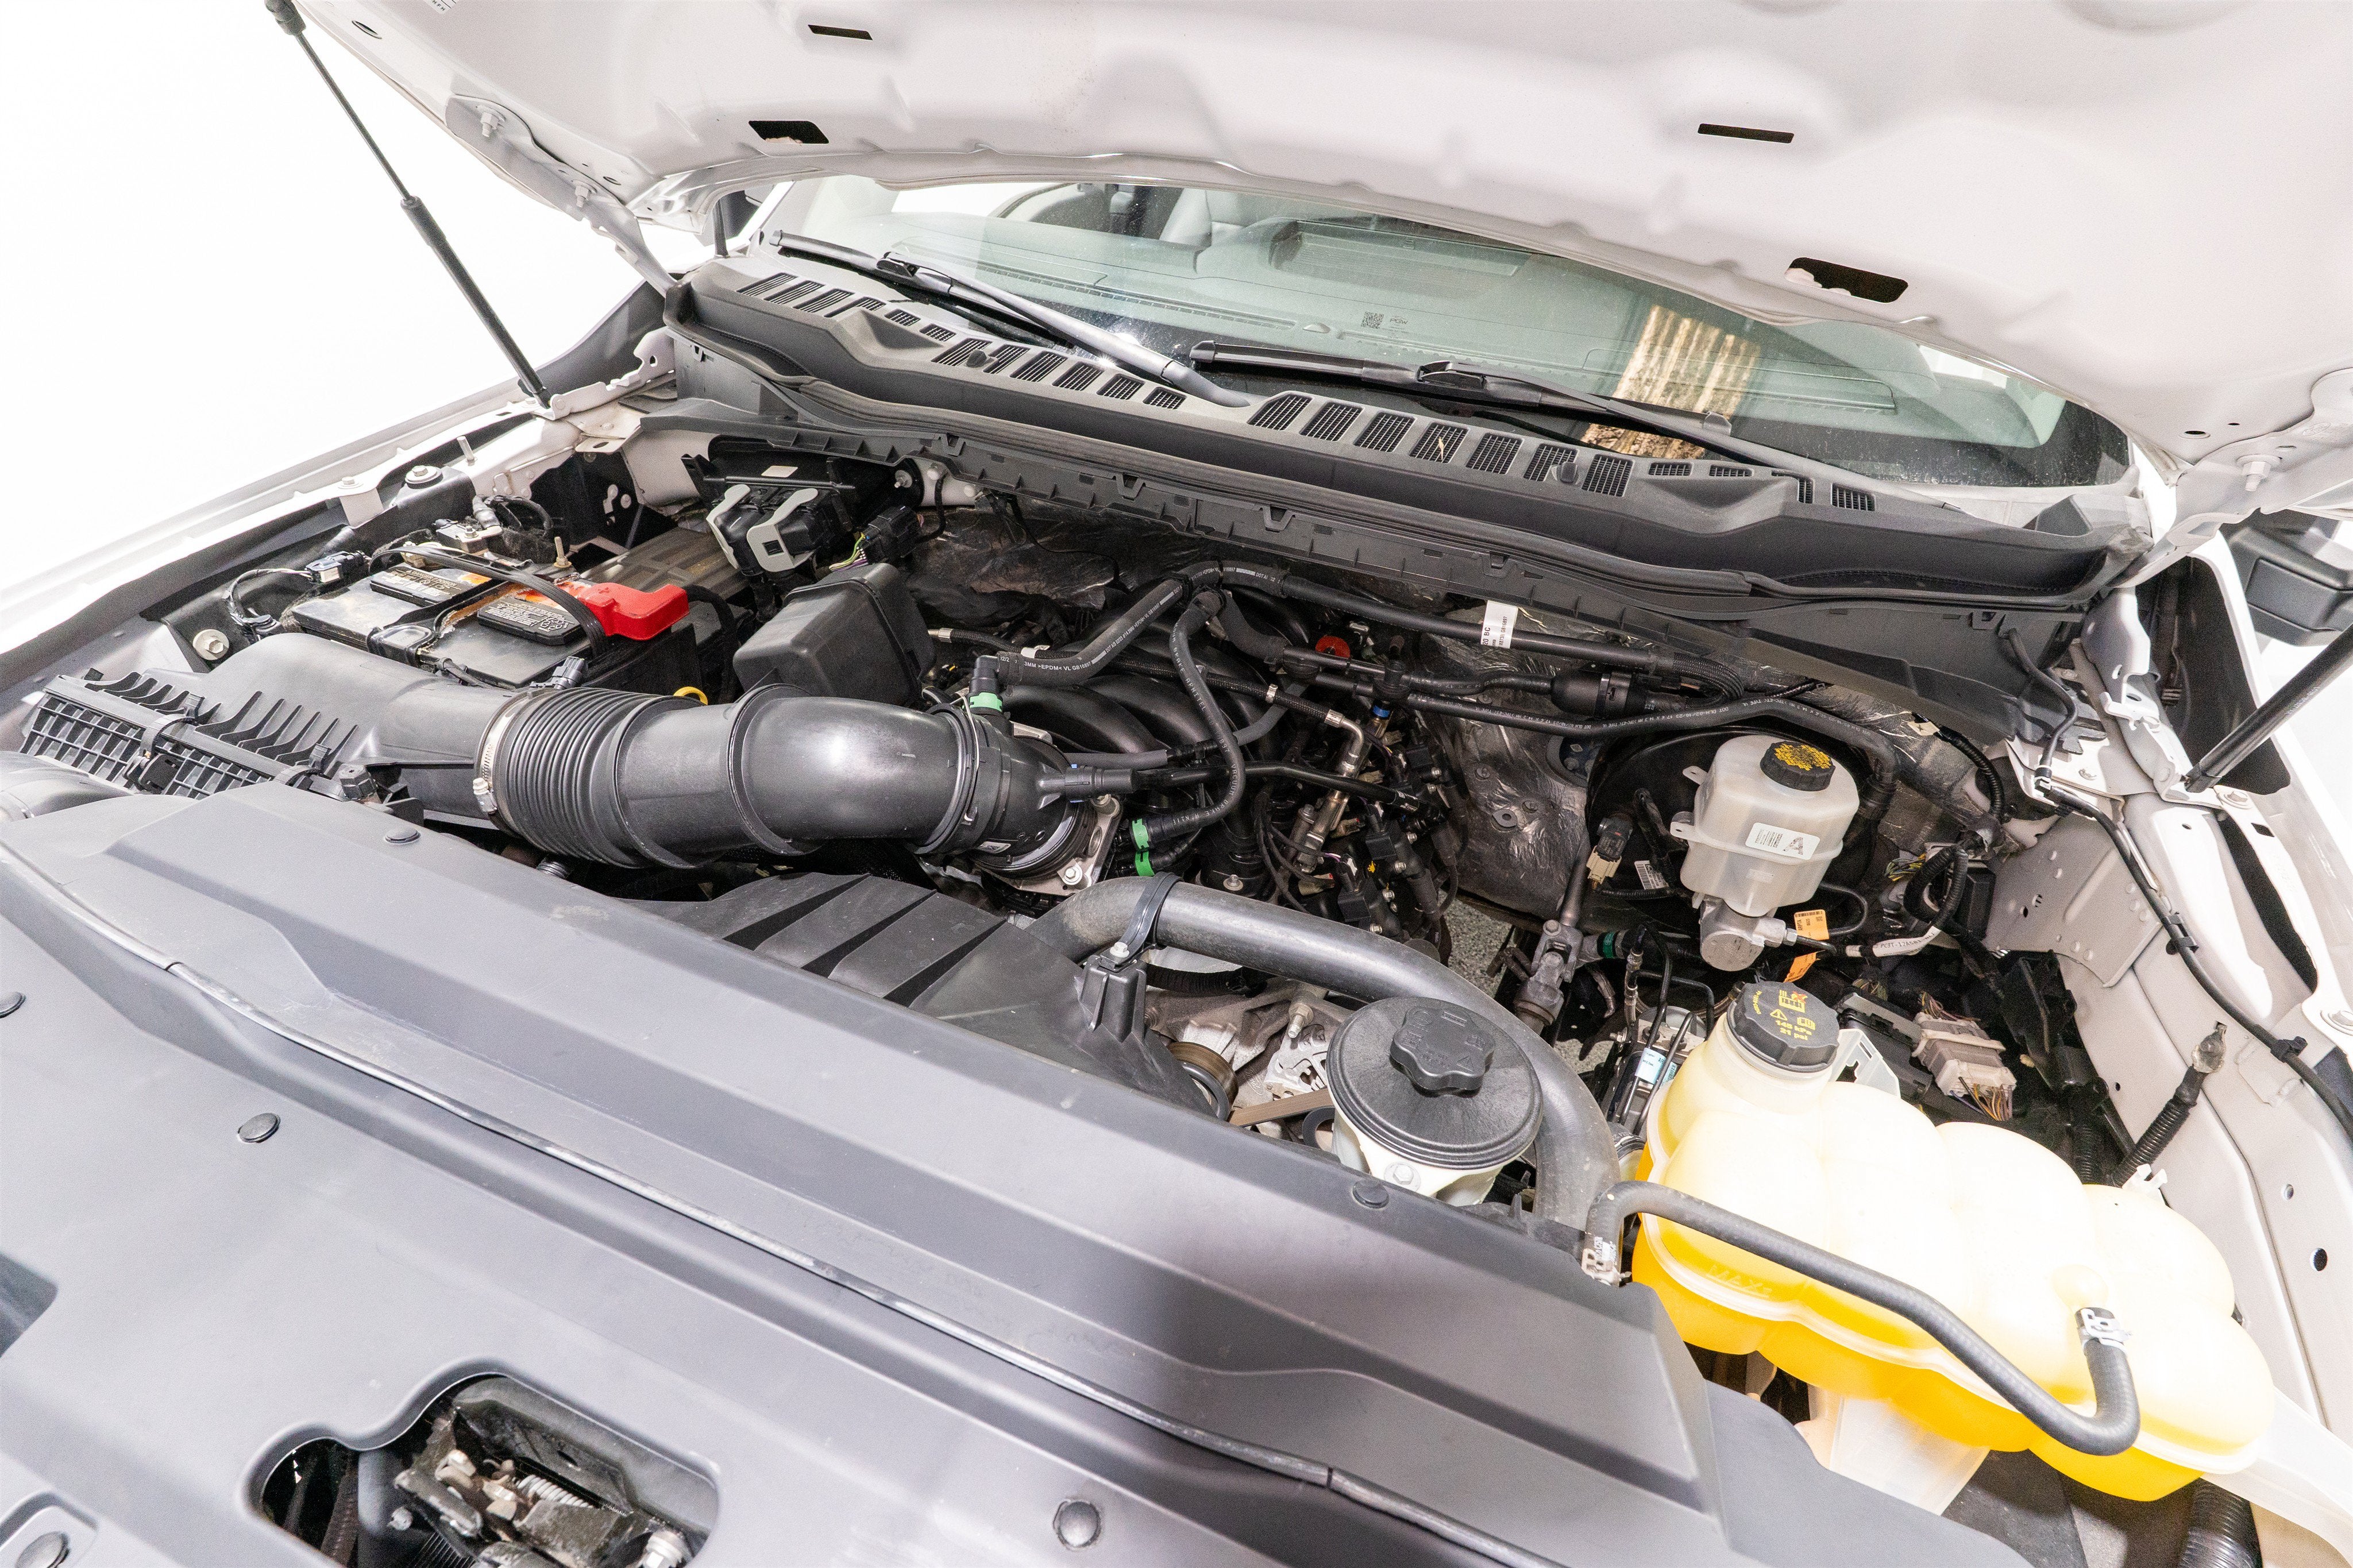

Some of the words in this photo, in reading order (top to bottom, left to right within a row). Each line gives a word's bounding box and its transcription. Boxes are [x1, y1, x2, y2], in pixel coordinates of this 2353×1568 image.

[1173, 647, 1186, 674] BRAKE
[1775, 1020, 1793, 1029] 145
[1794, 1025, 1812, 1036] kPa
[1780, 1028, 1791, 1036] 21
[1793, 1033, 1808, 1041] psi
